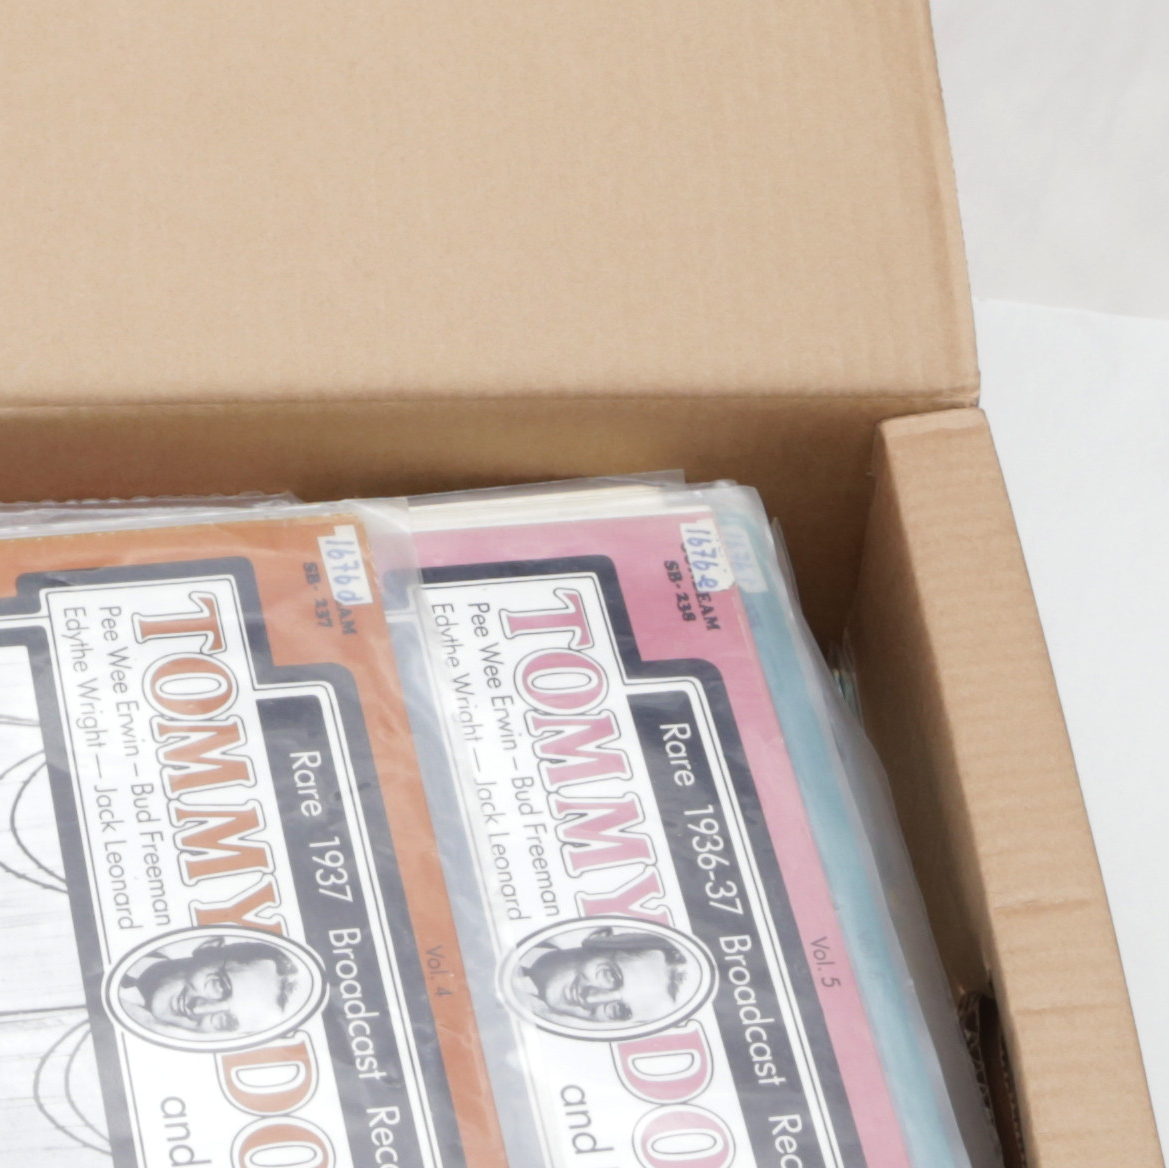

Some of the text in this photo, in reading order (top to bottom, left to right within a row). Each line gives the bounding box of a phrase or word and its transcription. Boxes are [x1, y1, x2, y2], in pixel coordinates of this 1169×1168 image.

[325, 540, 365, 602] 1676d
[61, 607, 94, 672] Edythe
[99, 606, 122, 641] Pee
[467, 602, 490, 638] Pee
[107, 646, 132, 694] Wee
[479, 642, 504, 689] Wee
[76, 677, 108, 748] Wright
[116, 700, 146, 757] Erwin
[452, 672, 484, 742] Wright
[491, 695, 523, 751] Erwin
[131, 590, 290, 937] TOMMY
[289, 751, 323, 817] Rare
[499, 587, 675, 928] TOMMY
[94, 785, 125, 832] Jack
[131, 783, 162, 823] Bud
[474, 778, 507, 824] Jack
[511, 776, 544, 816] Bud
[104, 840, 144, 930] Leonard
[139, 831, 171, 926] Freeman
[308, 836, 354, 903] 1937
[488, 832, 533, 920] Leonard
[523, 823, 560, 917] Freeman
[659, 722, 695, 787] Rare
[683, 805, 744, 915] 1936-37
[719, 935, 787, 1086] Broadcast
[427, 945, 452, 997] Vol. 4
[809, 936, 841, 988] Vol. 5
[329, 927, 387, 1082] Broadcast
[560, 1083, 614, 1155] and
